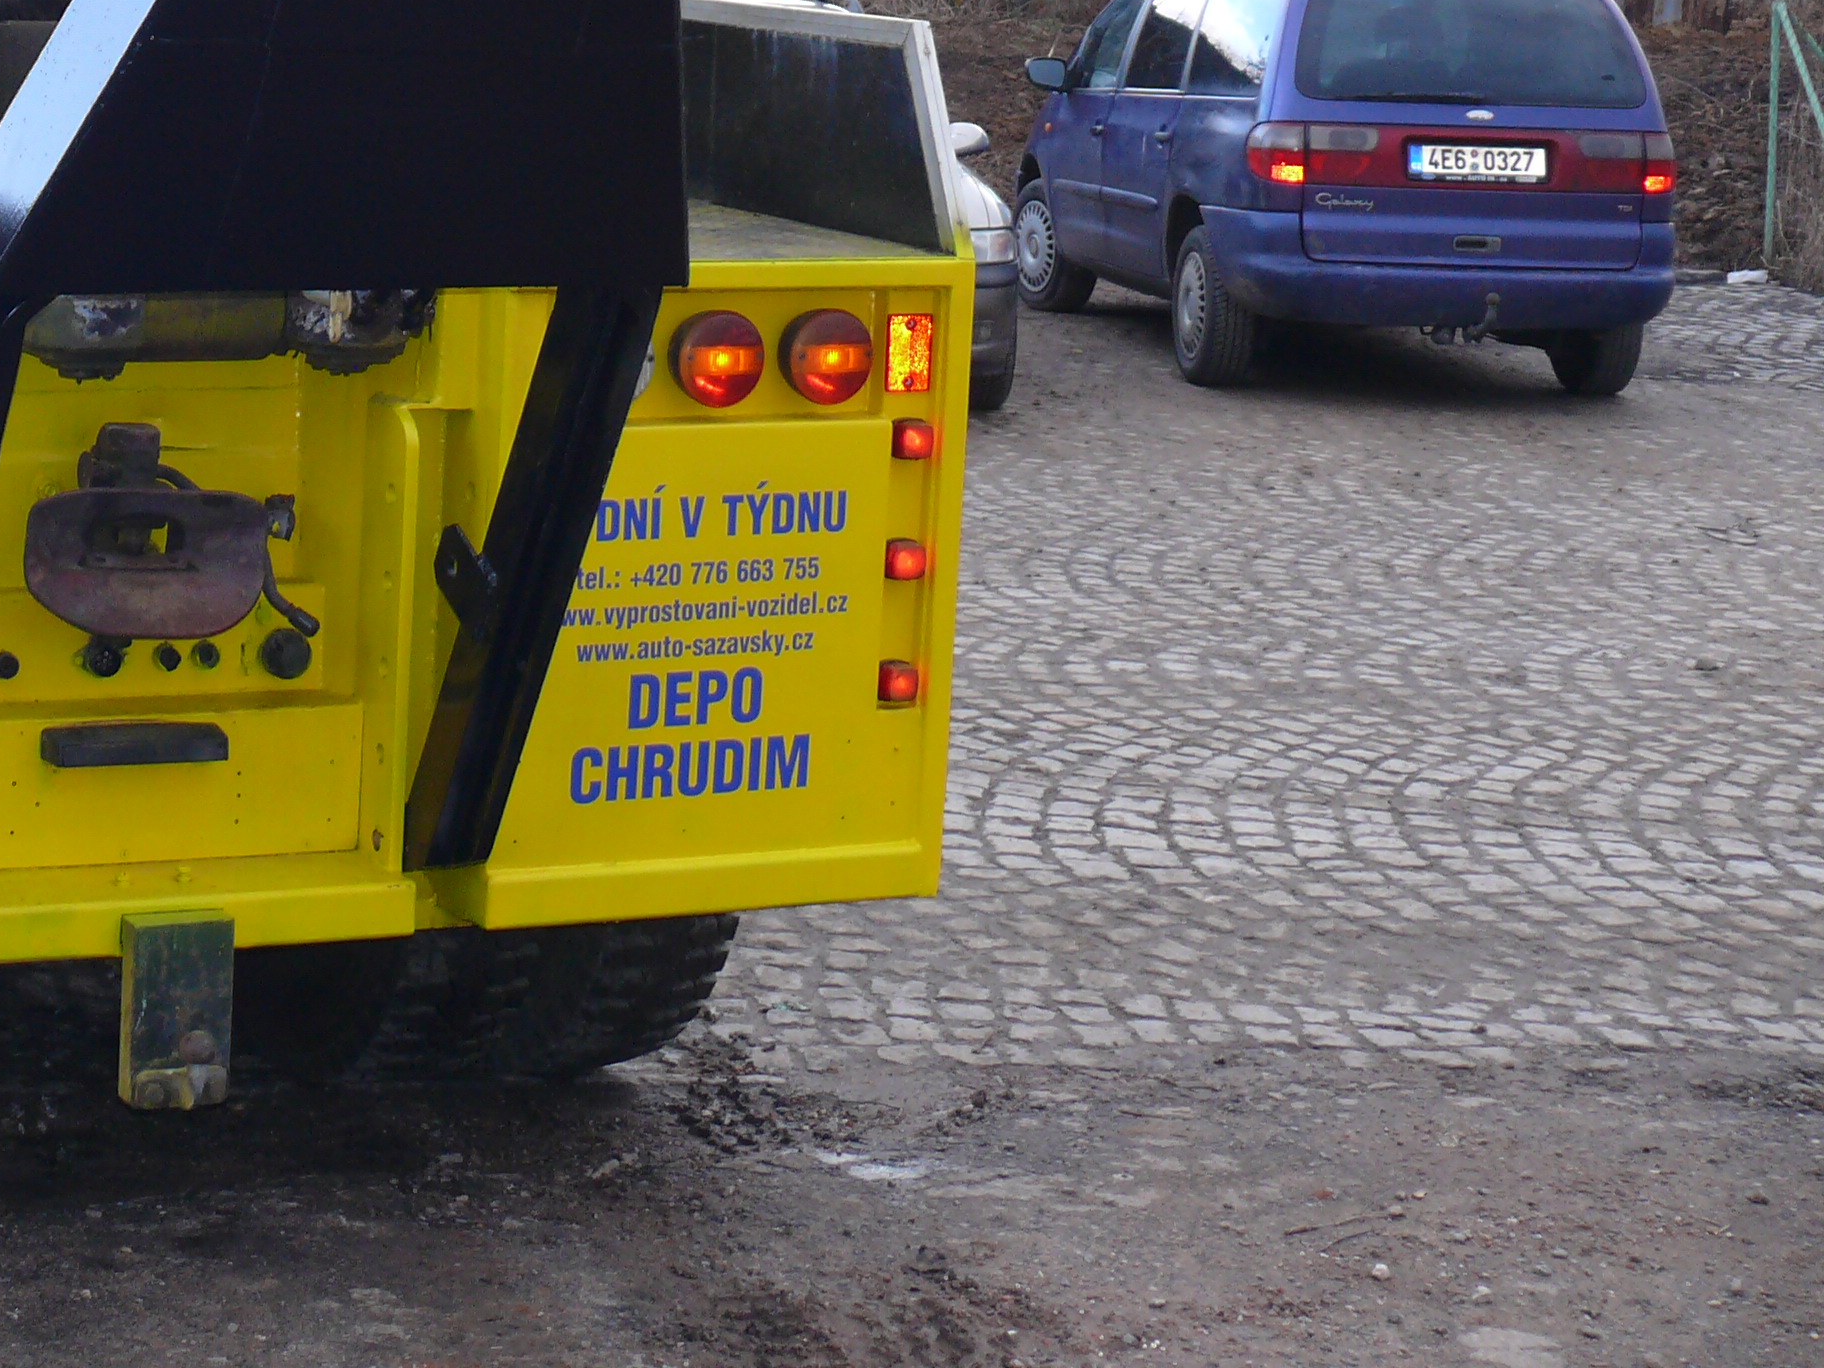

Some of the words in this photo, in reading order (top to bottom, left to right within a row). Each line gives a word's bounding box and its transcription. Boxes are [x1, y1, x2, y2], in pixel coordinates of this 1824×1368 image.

[1428, 148, 1466, 170] 4E6
[1483, 150, 1535, 172] 0327
[1315, 192, 1375, 213] Galaxy
[596, 484, 667, 542] DNÍ
[679, 495, 706, 539] V
[722, 480, 848, 536] TÝDNU
[576, 565, 622, 591] tel.:
[629, 561, 683, 588] +420
[690, 559, 729, 585] 776
[736, 557, 775, 583] 663
[782, 555, 821, 581] 755
[561, 590, 849, 631] ww.vyprostovani-vozidel.cz
[576, 628, 815, 663] www.auto-sazavsky.cz
[627, 665, 764, 730] DEPO
[568, 733, 811, 806] CHRUDIM
